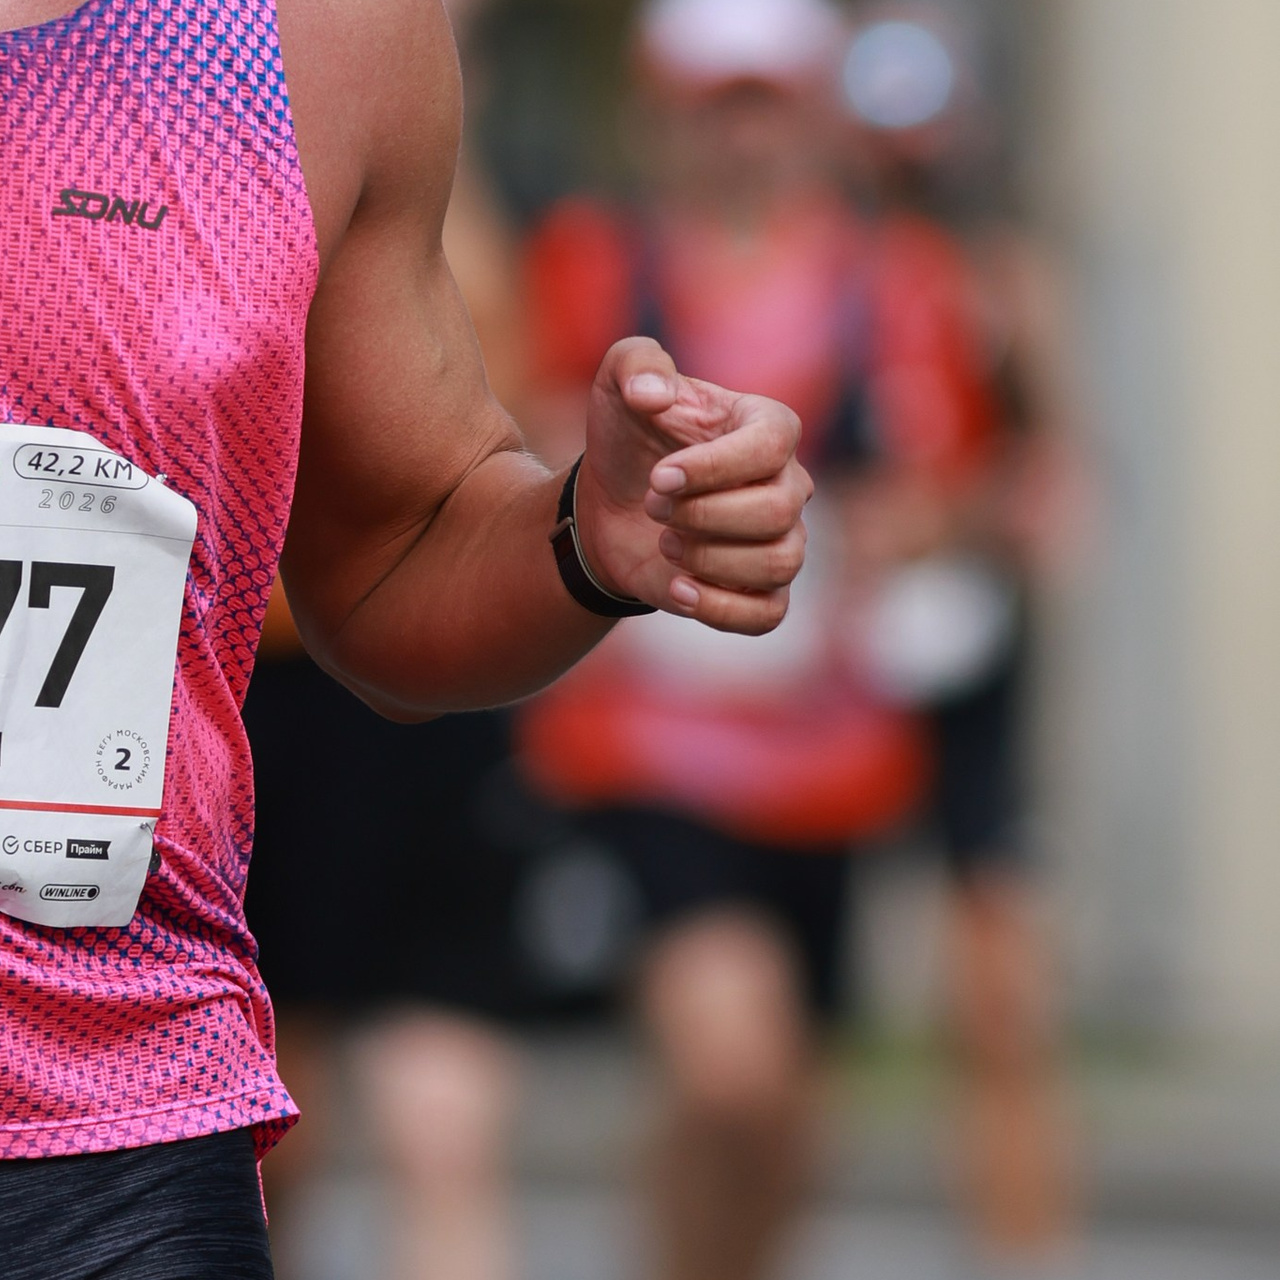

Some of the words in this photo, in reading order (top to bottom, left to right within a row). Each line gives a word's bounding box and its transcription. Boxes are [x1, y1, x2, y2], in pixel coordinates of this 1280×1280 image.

[27, 451, 85, 476] 42,2
[38, 488, 117, 514] 2026
[114, 748, 132, 771] 2
[23, 839, 63, 855] СБЕР
[69, 841, 104, 856] Прайм
[43, 887, 88, 899] WINLINE
